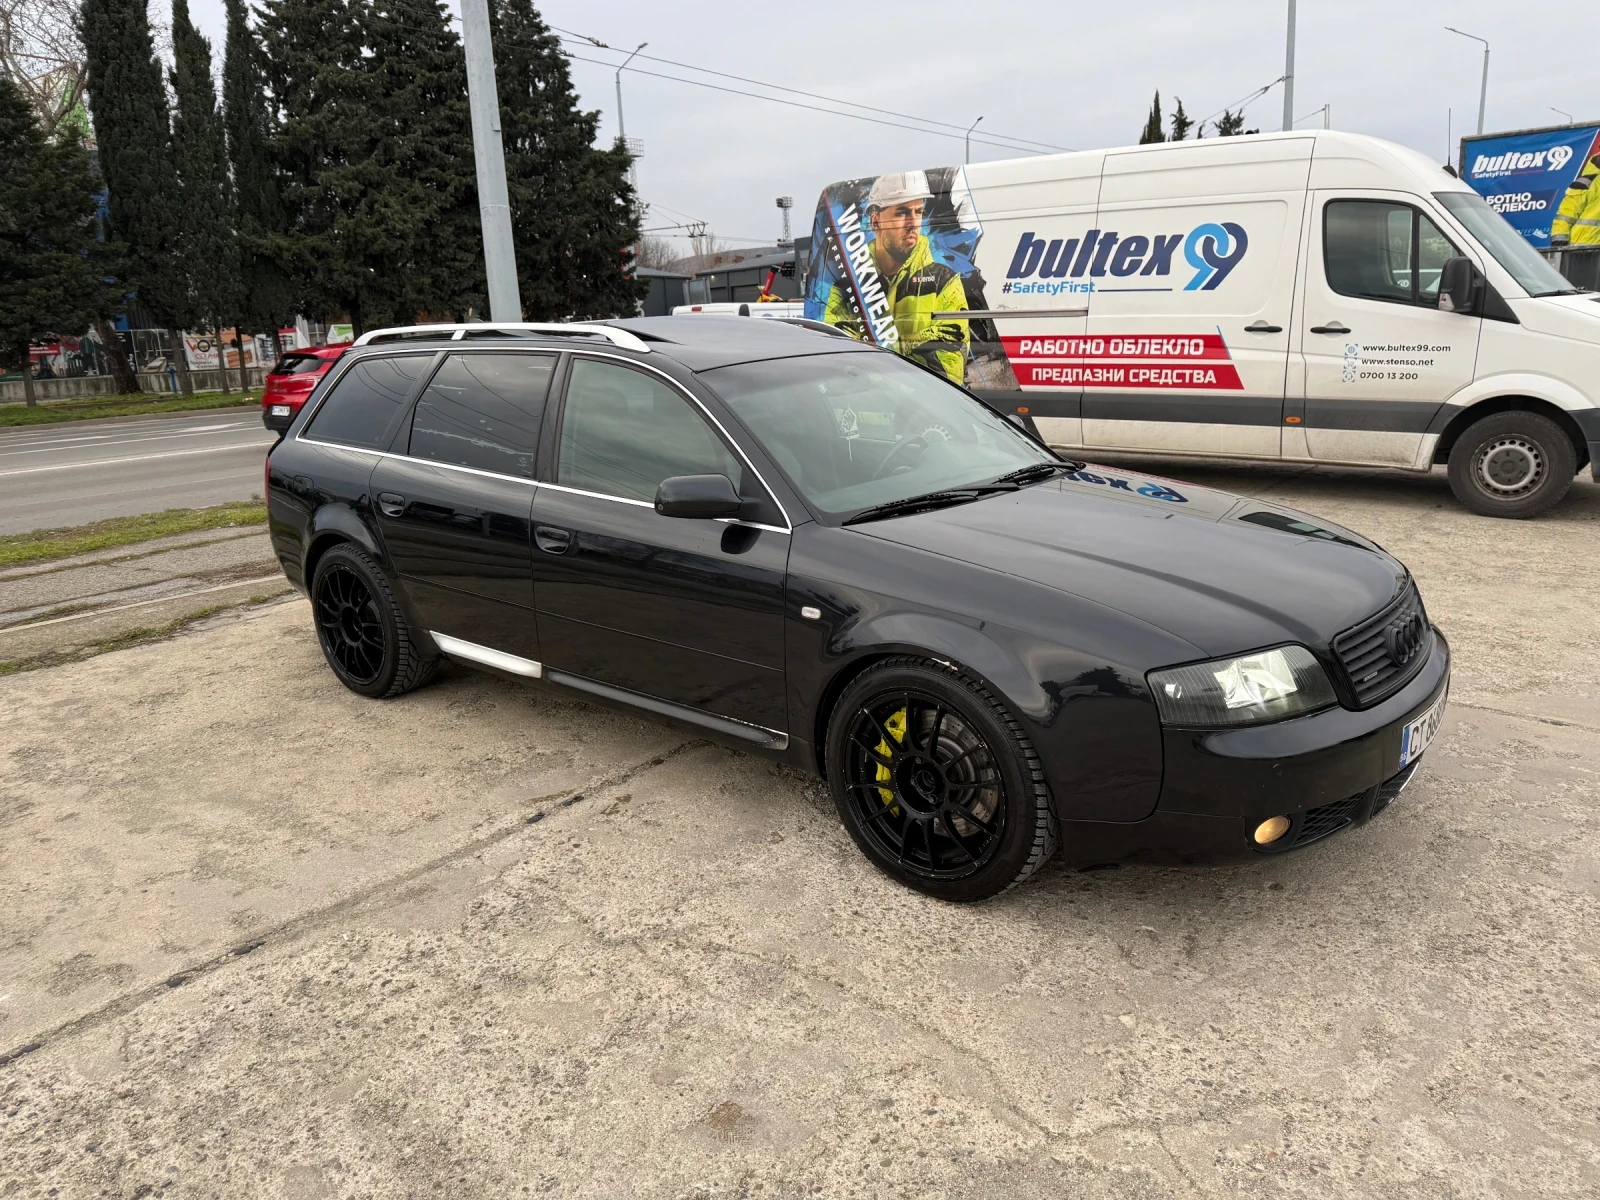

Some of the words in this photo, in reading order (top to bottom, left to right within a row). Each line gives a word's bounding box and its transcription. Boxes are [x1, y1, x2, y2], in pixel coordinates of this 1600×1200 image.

[824, 226, 847, 279] SAFETY
[837, 203, 899, 348] WORKWEAR
[1002, 280, 1096, 296] #SafetyFirst
[1019, 339, 1104, 355] РАБОТНО
[1109, 338, 1204, 356] ОБЛЕКЛО
[1362, 344, 1451, 352] www.bultex99.com
[1361, 358, 1434, 366] www.stenso.net
[1032, 368, 1124, 383] ПРЕДПАЗНИ
[1129, 368, 1217, 385] СРЕДСТВА
[1360, 372, 1384, 380] 0700
[1387, 372, 1396, 380] 13
[1399, 372, 1418, 380] 200
